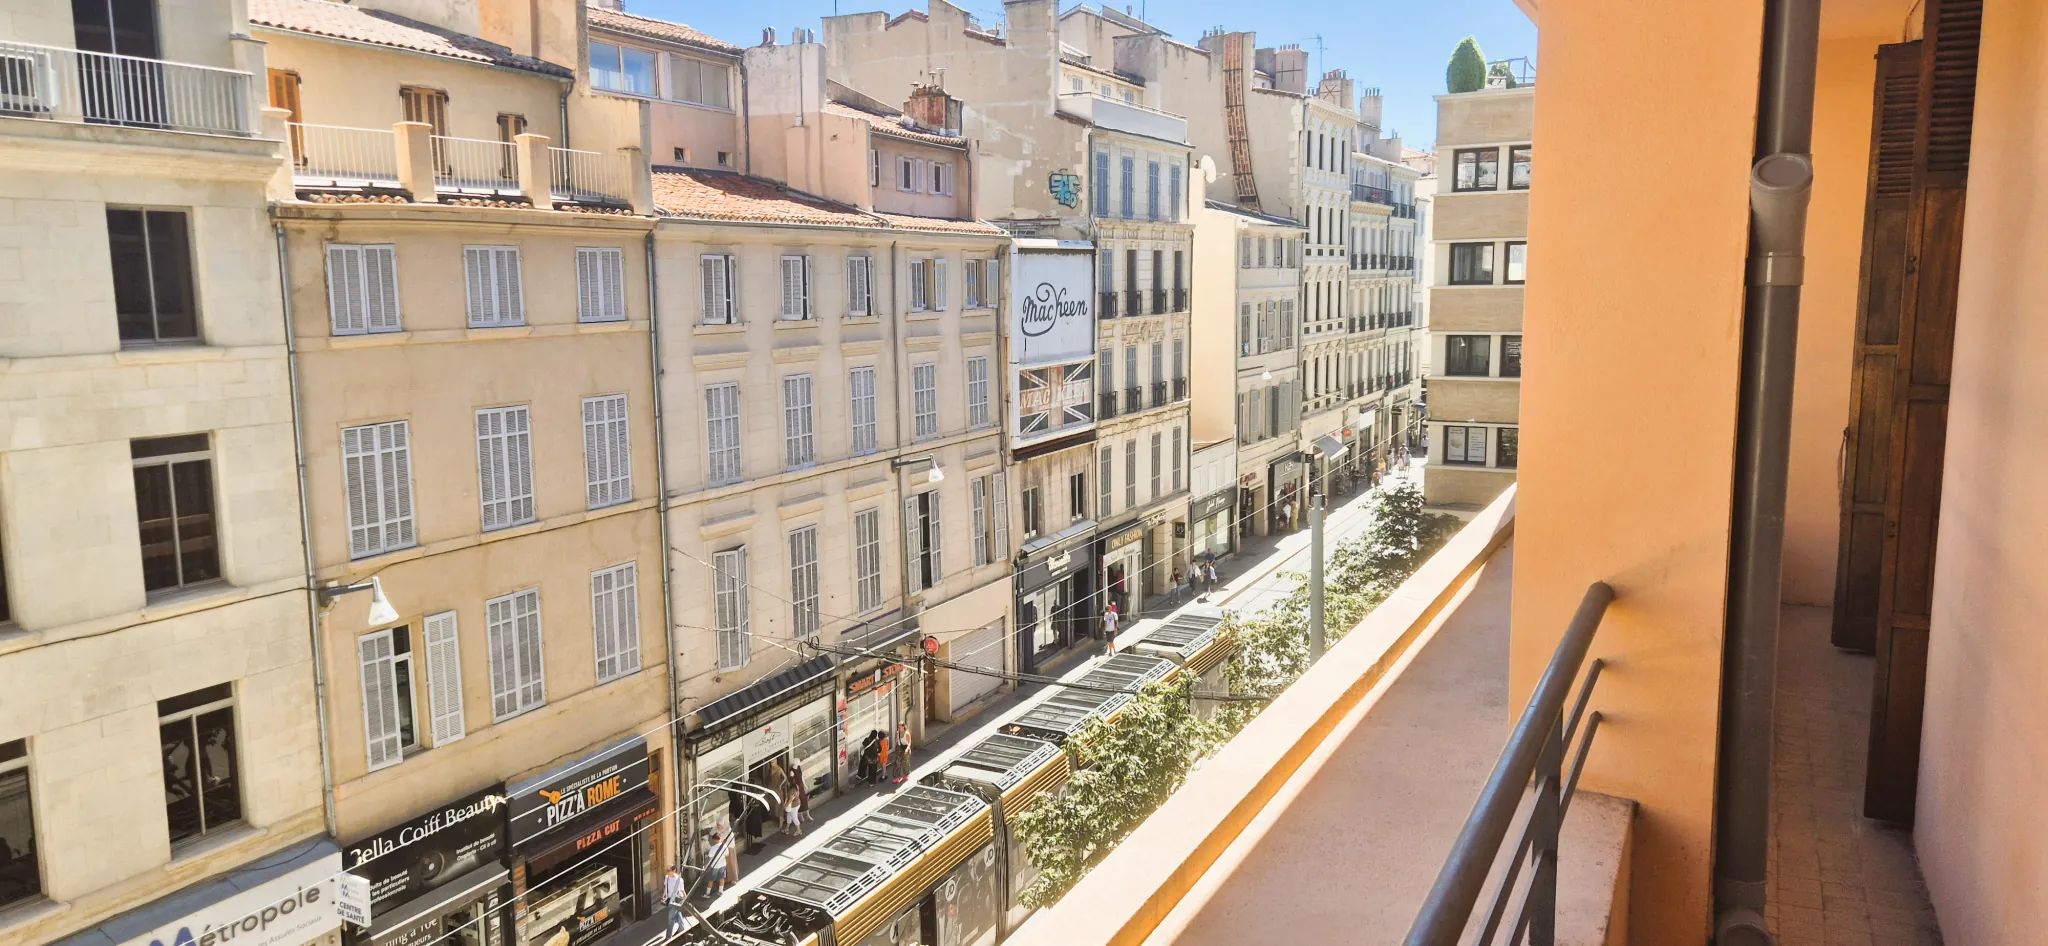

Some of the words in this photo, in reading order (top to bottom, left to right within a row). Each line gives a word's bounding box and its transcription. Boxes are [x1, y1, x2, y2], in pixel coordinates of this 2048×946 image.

[1111, 536, 1124, 549] ONLY
[1125, 528, 1143, 545] FASHION
[587, 775, 621, 807] ROME
[400, 813, 440, 845] Coiff
[576, 831, 602, 850] PIZZA
[605, 820, 621, 835] CUT
[371, 884, 406, 904] rofessionnels
[337, 908, 345, 916] DE
[346, 911, 365, 924] SANTÉ
[340, 901, 361, 915] CENTRE
